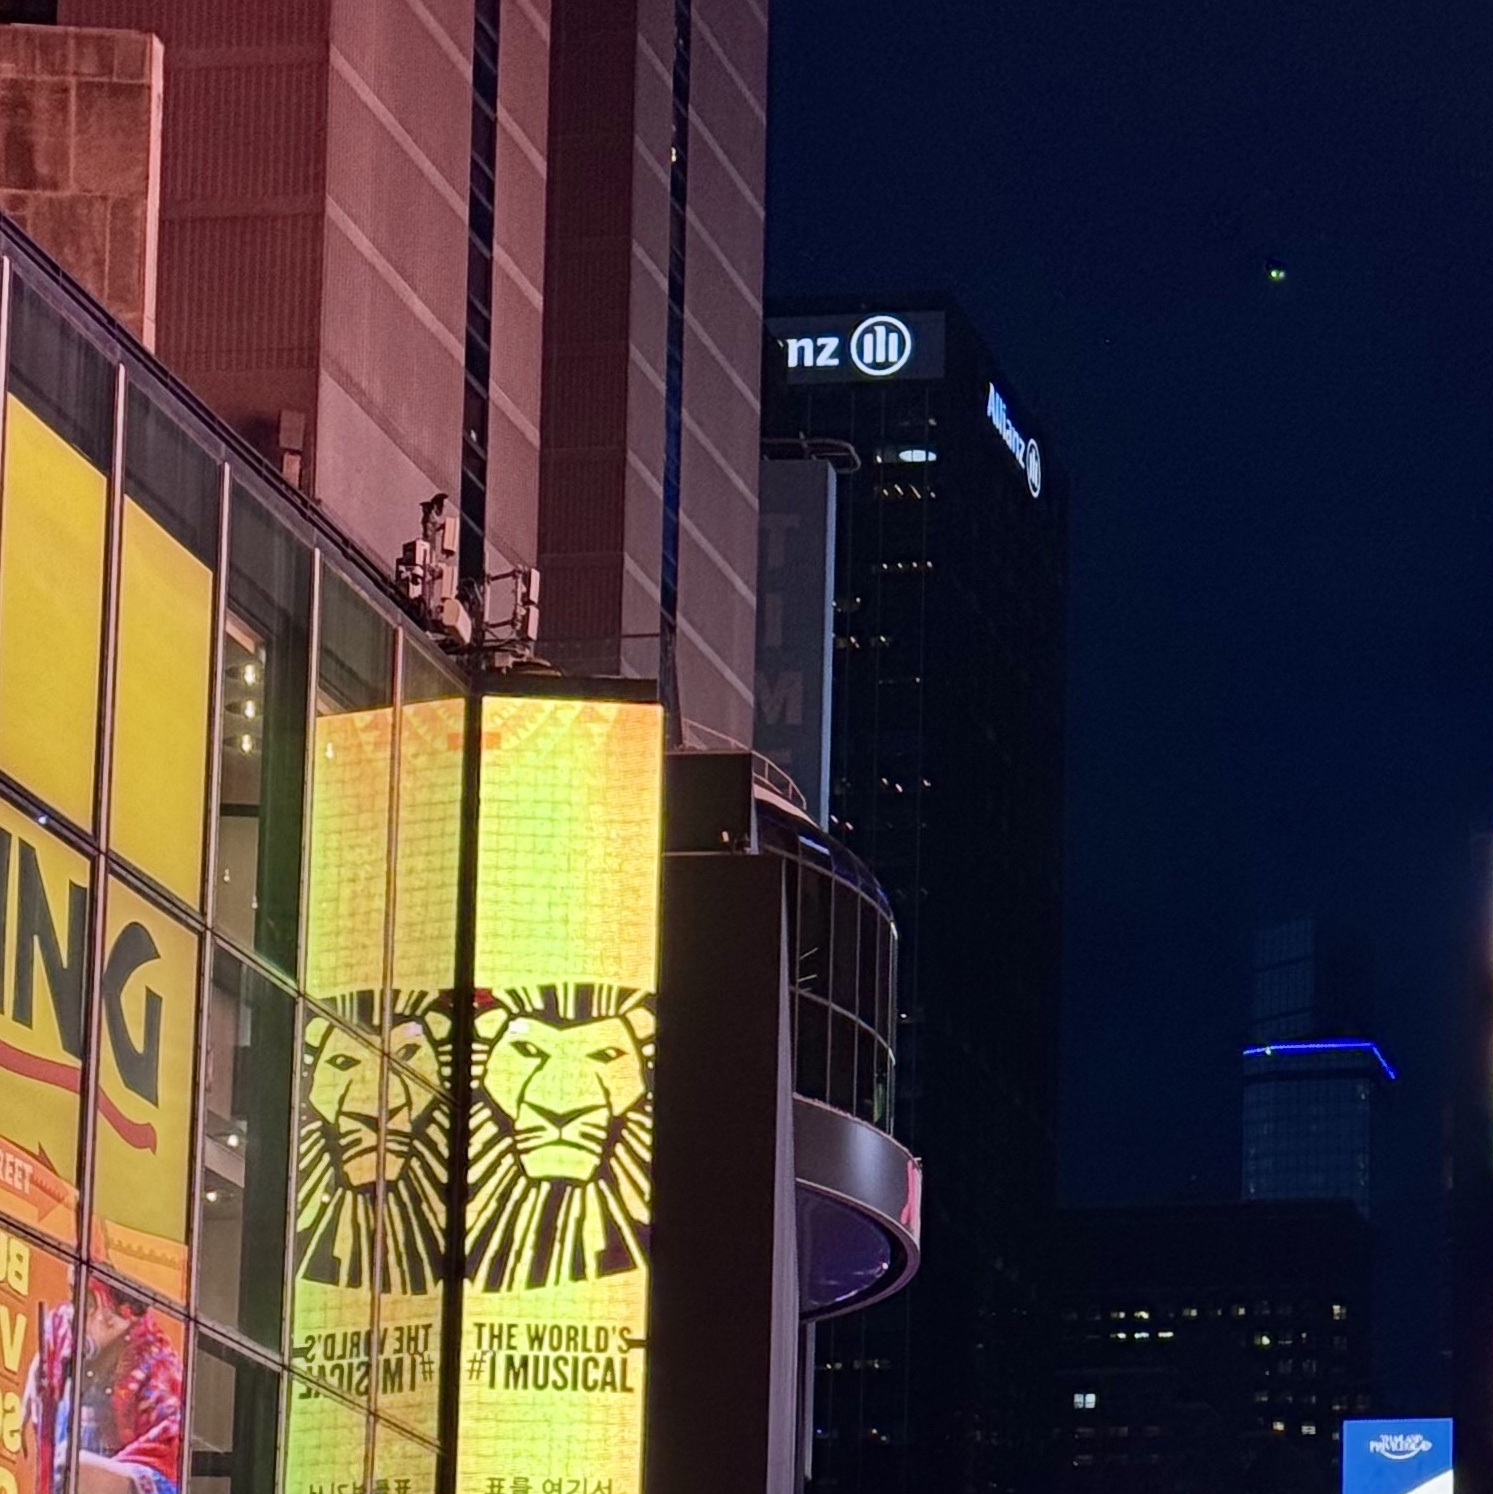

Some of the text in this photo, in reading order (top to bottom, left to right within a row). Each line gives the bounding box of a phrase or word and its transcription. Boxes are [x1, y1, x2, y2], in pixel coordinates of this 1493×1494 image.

[0, 1147, 33, 1196] EET
[473, 1322, 632, 1354] THE WORLD'S
[507, 1356, 634, 1394] MUSICAL
